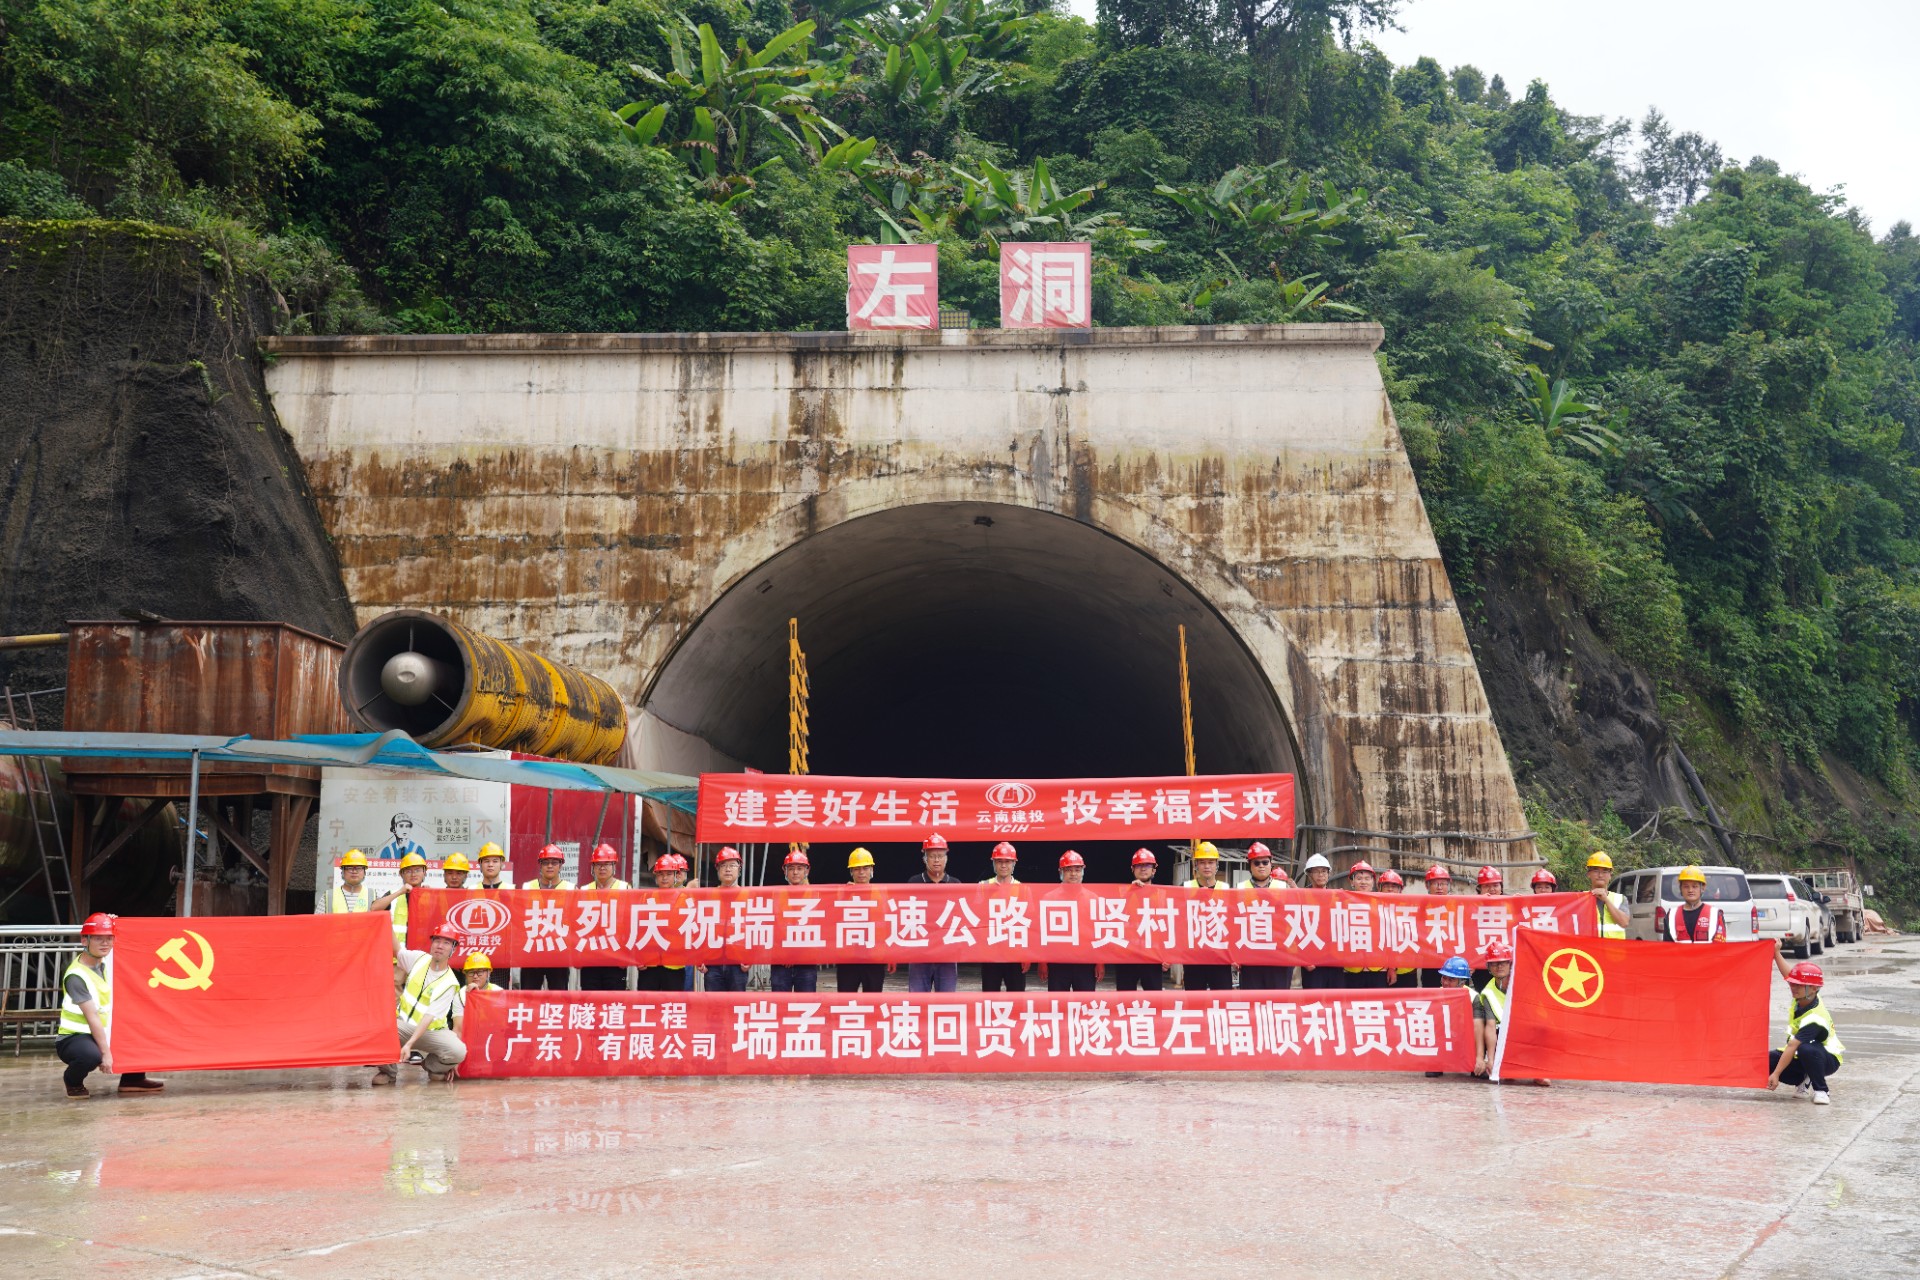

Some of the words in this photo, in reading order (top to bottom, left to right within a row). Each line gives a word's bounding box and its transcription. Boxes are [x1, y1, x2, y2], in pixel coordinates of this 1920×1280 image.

[856, 250, 932, 327] 左
[1008, 248, 1085, 324] 洞
[343, 786, 480, 804] 安全着装示意图
[723, 789, 960, 828] 建美好生活
[1060, 787, 1281, 826] 投幸福未来
[975, 809, 1045, 824] 云南建投
[991, 824, 1030, 833] YCIH
[507, 1002, 688, 1031] 中坚隧道工程
[731, 999, 1454, 1060] 瑞孟高速回贤村隧道左幅顺利贯通!
[485, 1033, 716, 1062] （广东）有限公司
